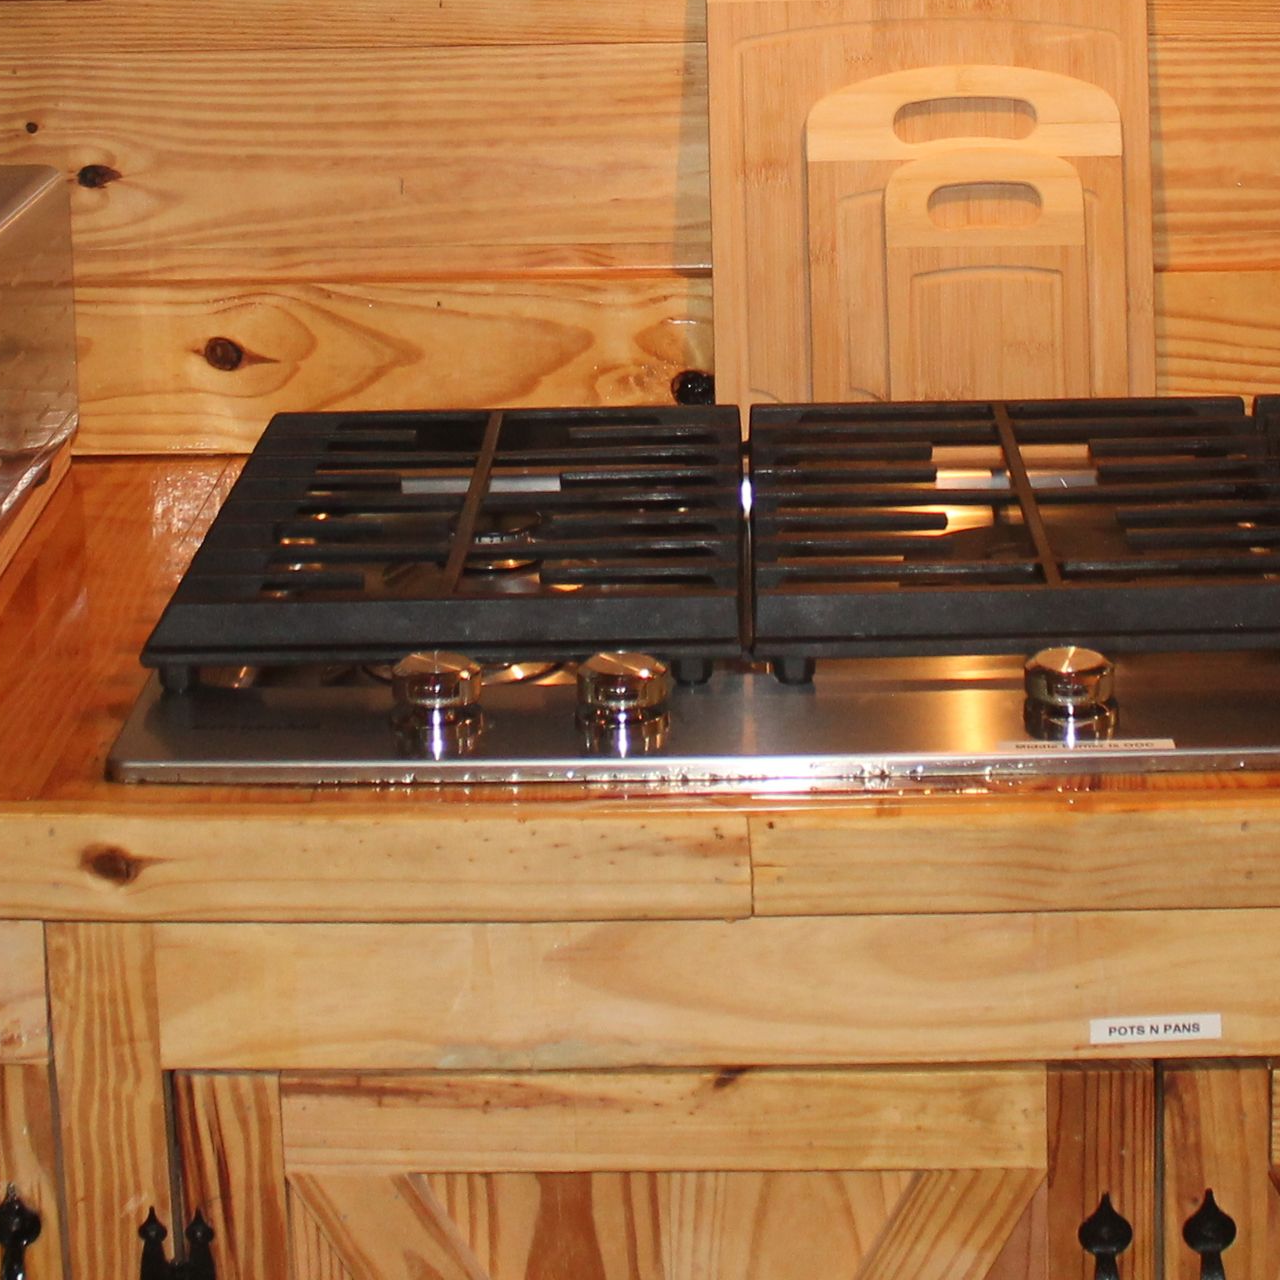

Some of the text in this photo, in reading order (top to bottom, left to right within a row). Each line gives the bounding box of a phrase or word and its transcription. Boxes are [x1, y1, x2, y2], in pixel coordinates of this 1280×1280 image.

[1108, 1022, 1201, 1037] POTS N PANS
